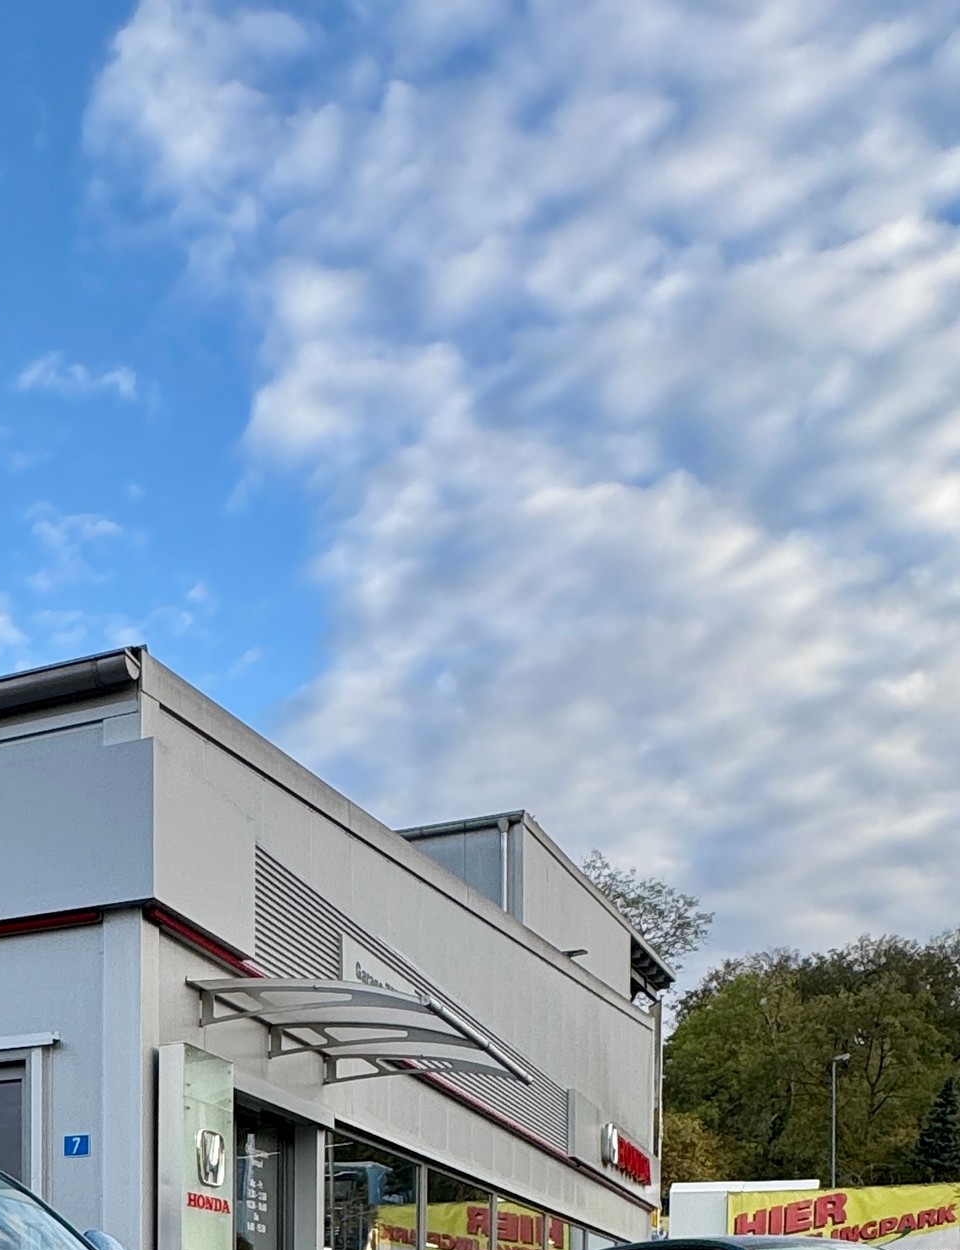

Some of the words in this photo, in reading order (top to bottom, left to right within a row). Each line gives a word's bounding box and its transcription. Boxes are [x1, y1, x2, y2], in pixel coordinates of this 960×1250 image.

[72, 1137, 81, 1154] 7
[187, 1192, 230, 1214] HONDA
[734, 1192, 847, 1236] HIER
